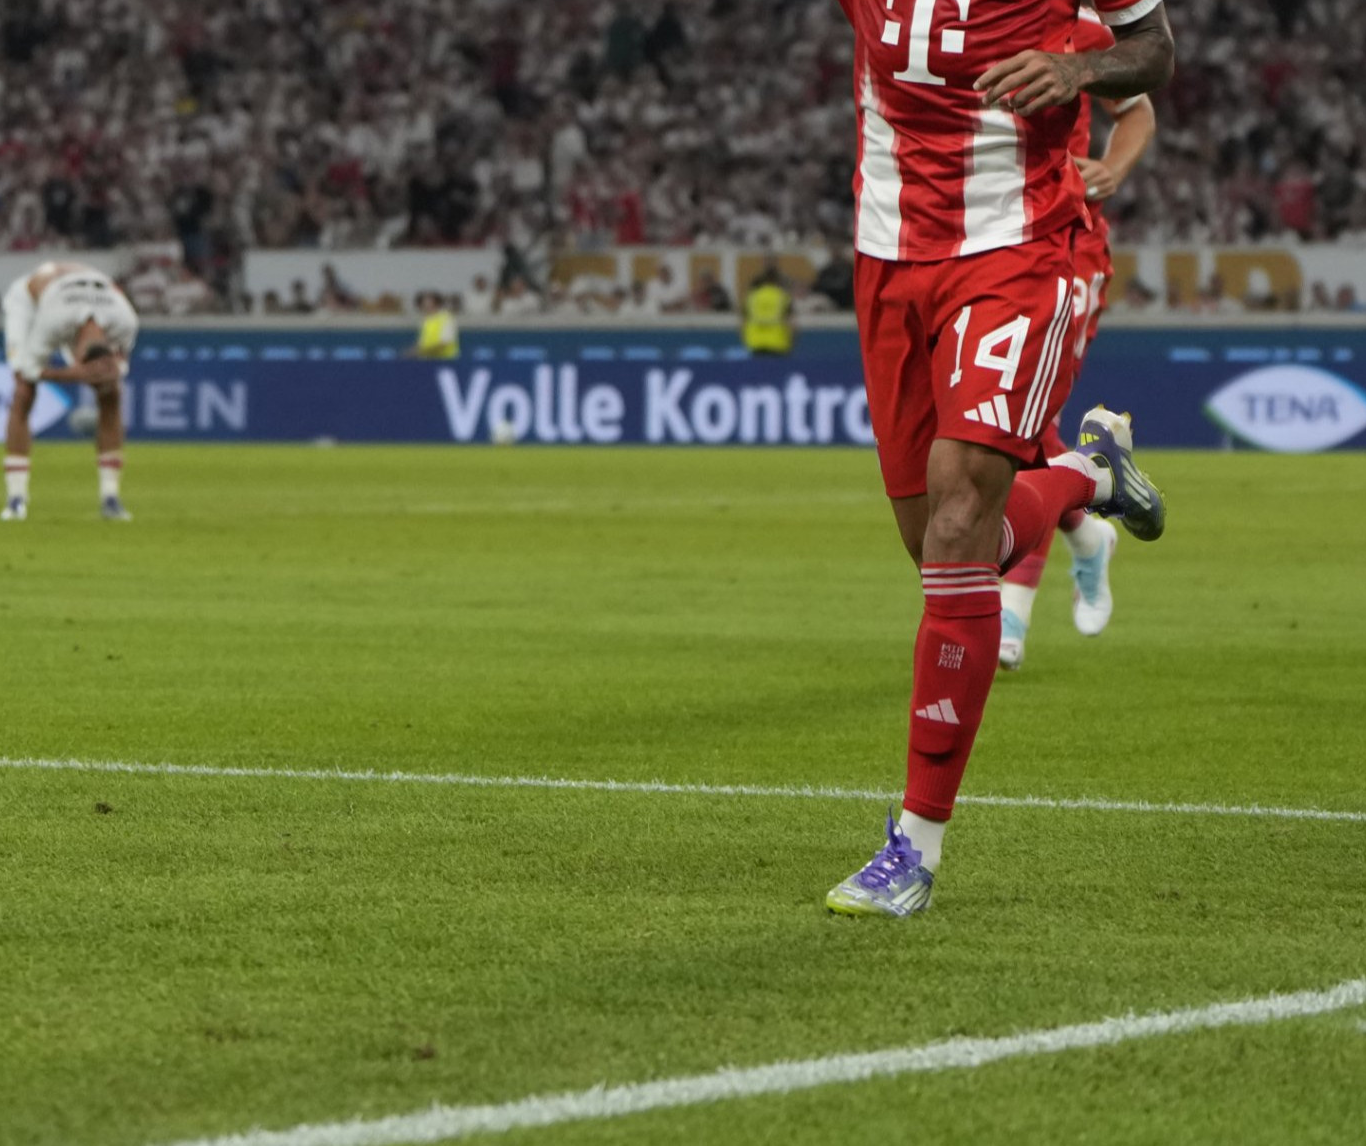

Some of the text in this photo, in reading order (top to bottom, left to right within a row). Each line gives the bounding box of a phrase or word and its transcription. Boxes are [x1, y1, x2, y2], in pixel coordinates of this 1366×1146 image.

[949, 305, 1031, 391] 14
[437, 363, 875, 444] Volle Kontro
[1241, 391, 1341, 425] TENA
